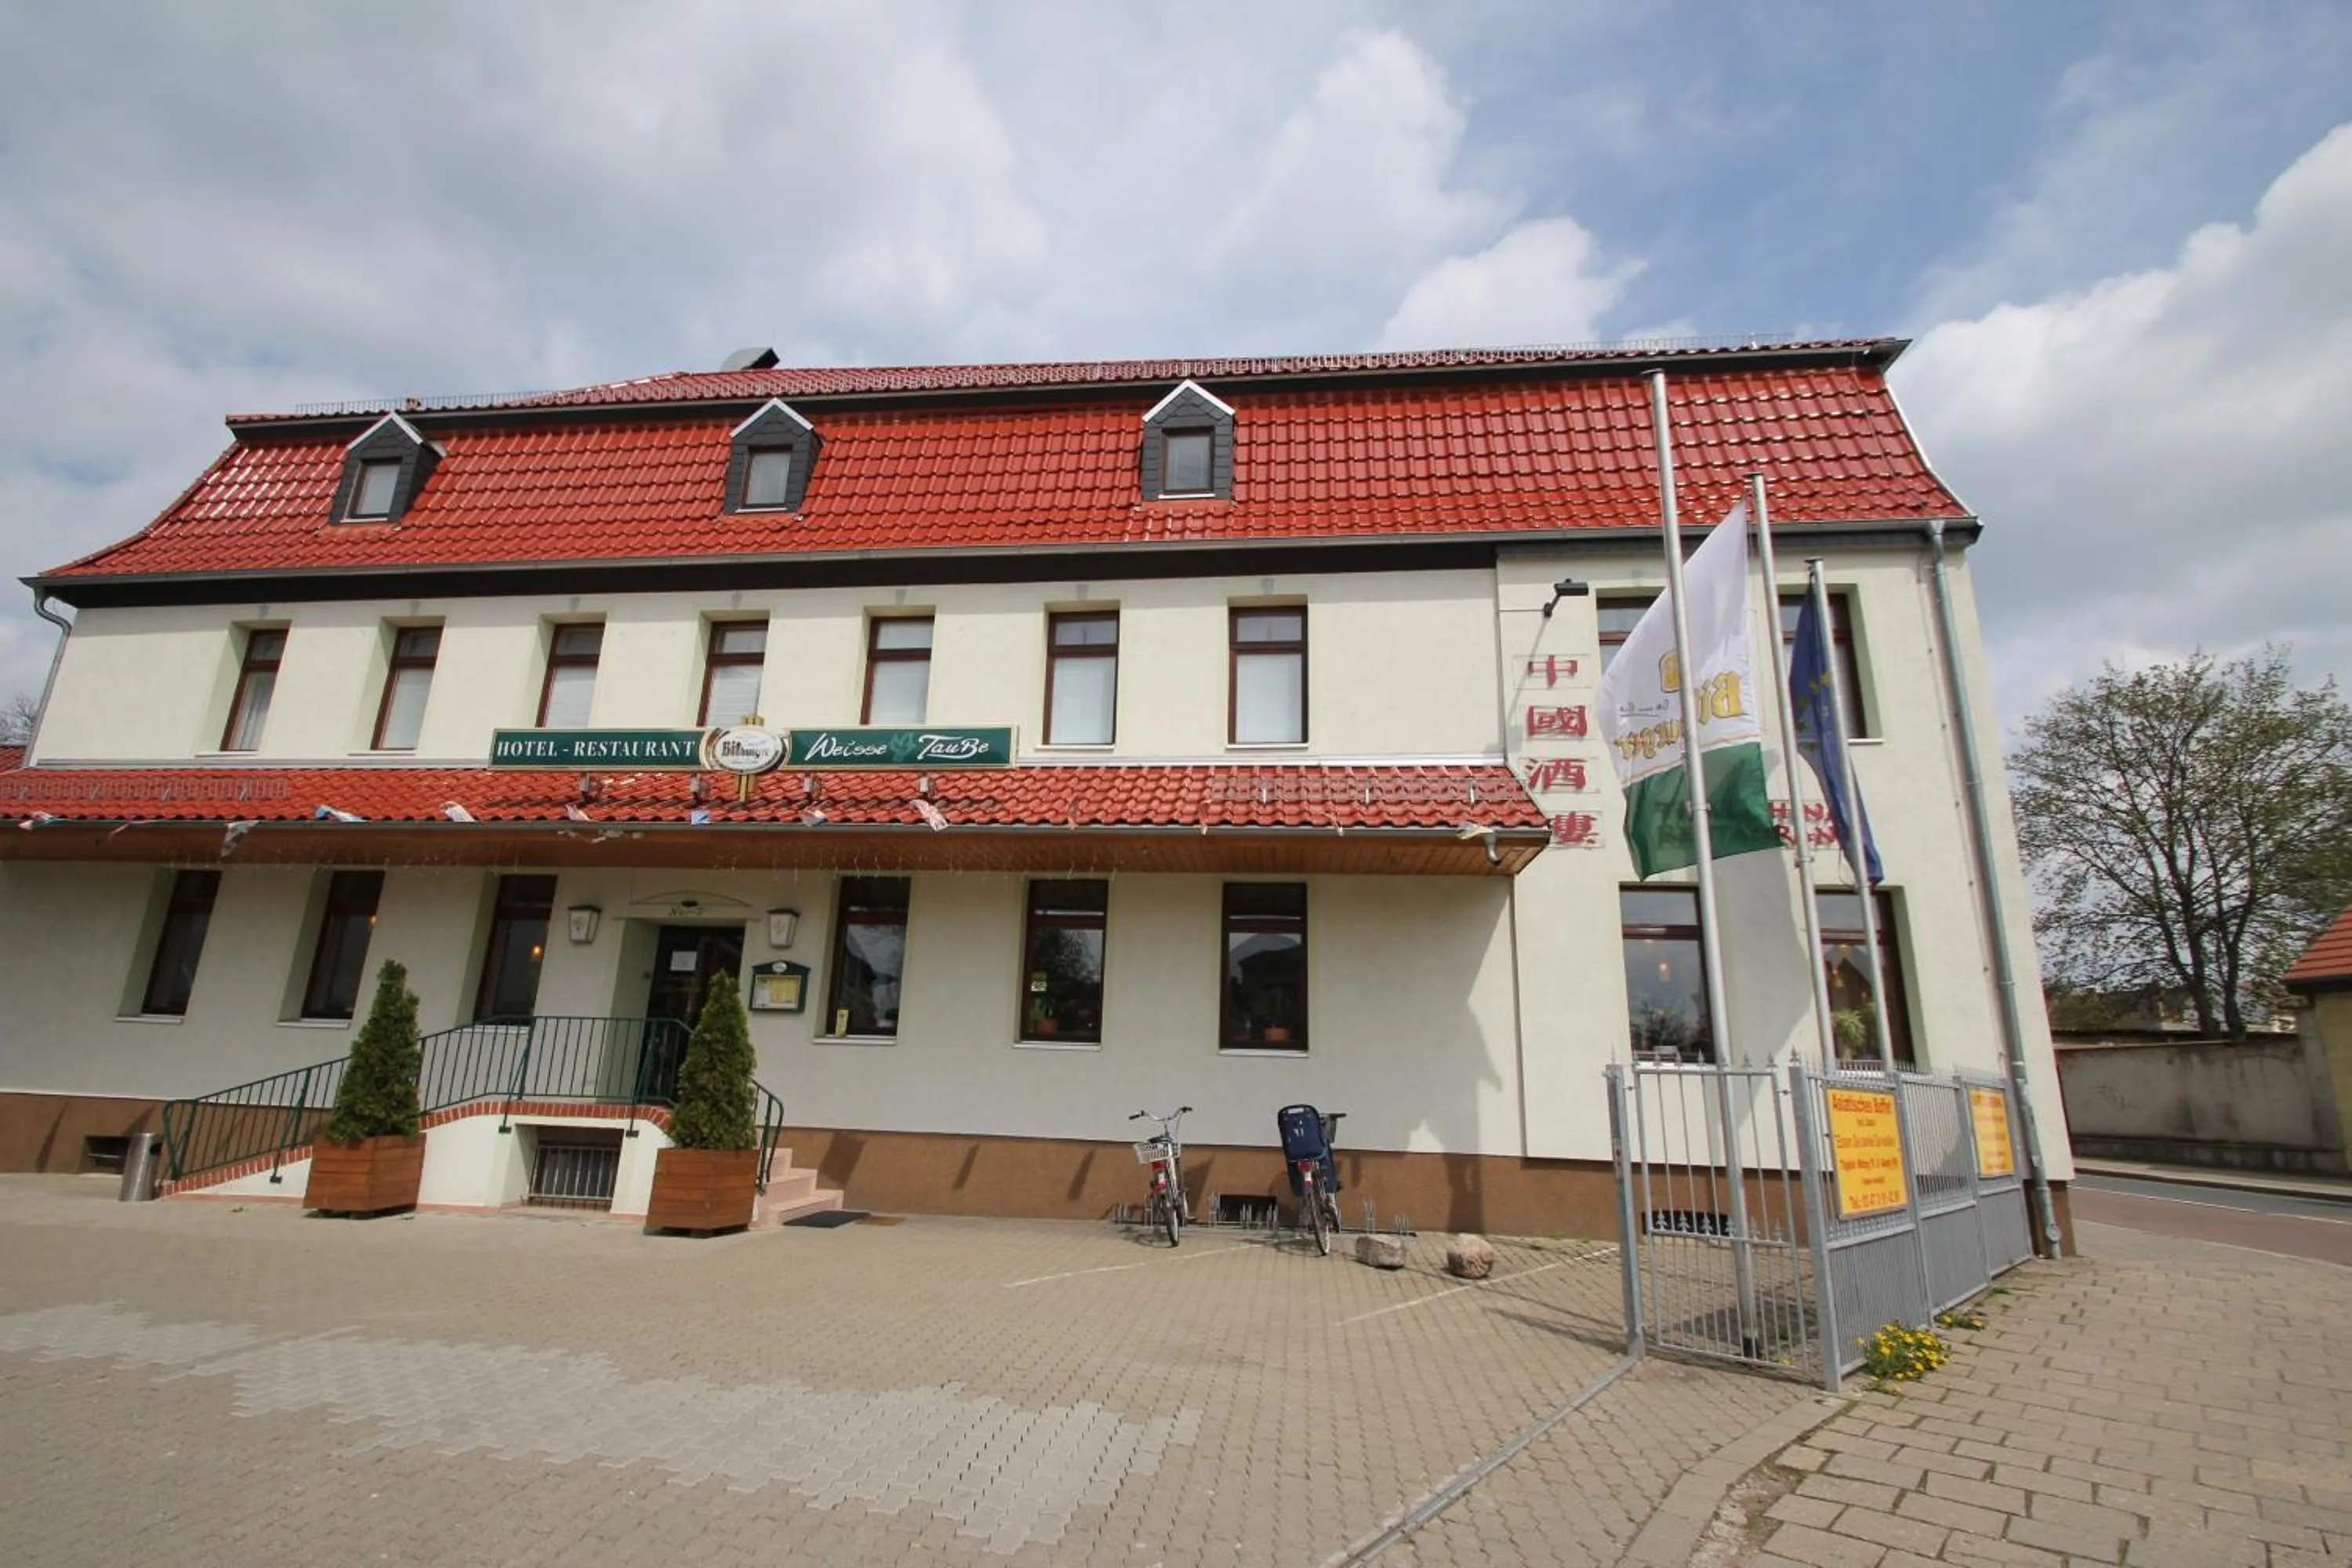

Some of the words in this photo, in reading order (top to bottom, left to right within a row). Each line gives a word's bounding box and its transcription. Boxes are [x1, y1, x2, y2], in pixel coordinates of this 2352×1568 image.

[497, 740, 557, 757] HOTEL
[573, 739, 696, 757] RESTAURANT
[804, 732, 887, 761] Weisse
